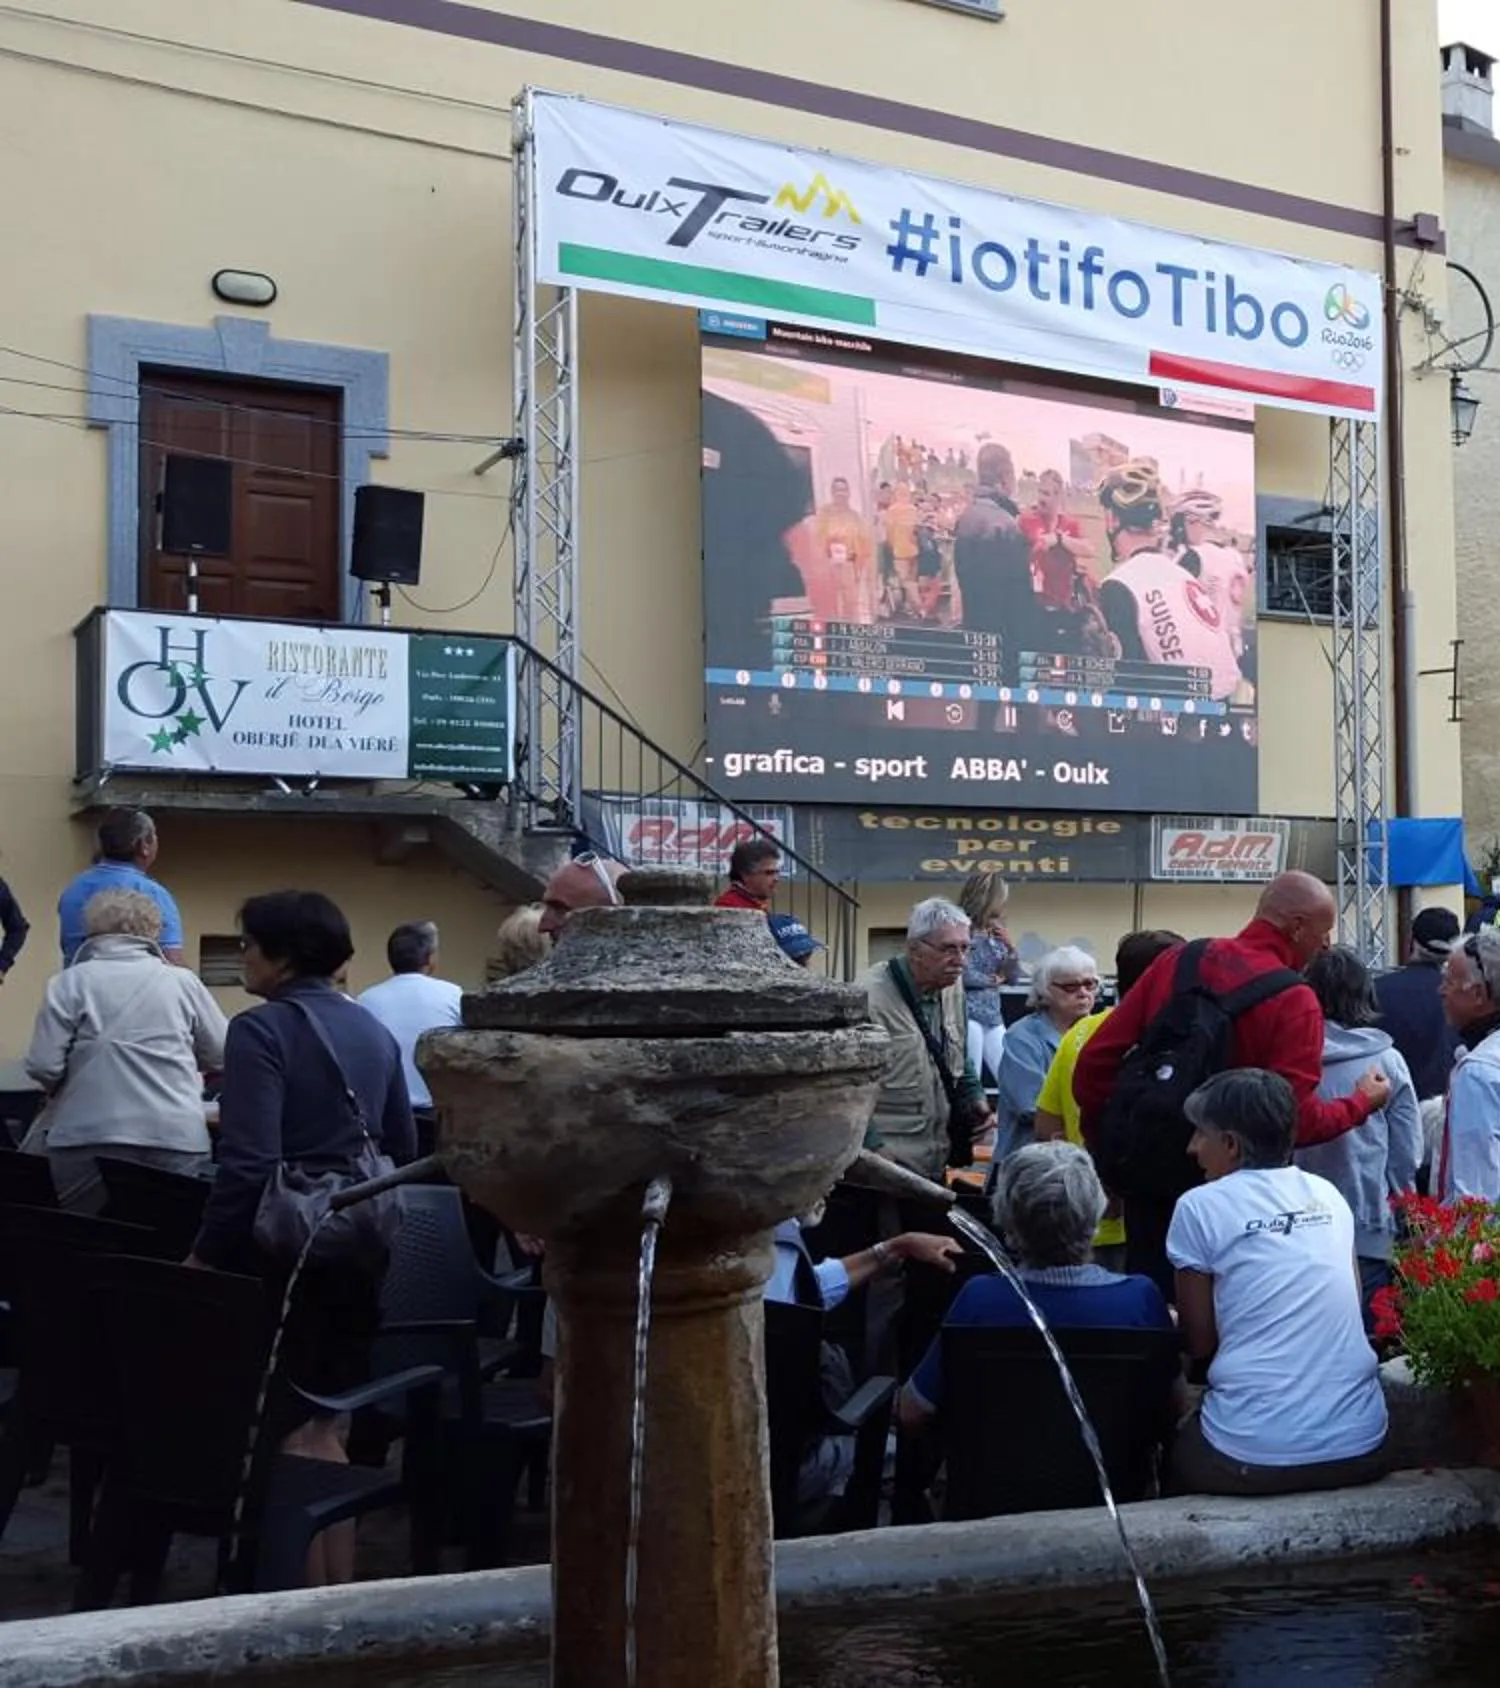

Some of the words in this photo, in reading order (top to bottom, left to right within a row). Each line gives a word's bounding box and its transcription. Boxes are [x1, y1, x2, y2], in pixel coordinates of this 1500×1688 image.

[886, 208, 1310, 348] #iotifoTibo
[1146, 589, 1184, 661] SUISSE
[267, 639, 389, 680] RISTORANTE
[288, 714, 348, 730] HOTEL
[723, 749, 825, 777] grafica
[854, 755, 928, 782] sport
[1053, 761, 1110, 785] Oulx
[858, 812, 1121, 837] tecnologie
[956, 838, 1037, 855] per
[920, 857, 1069, 873] eventi
